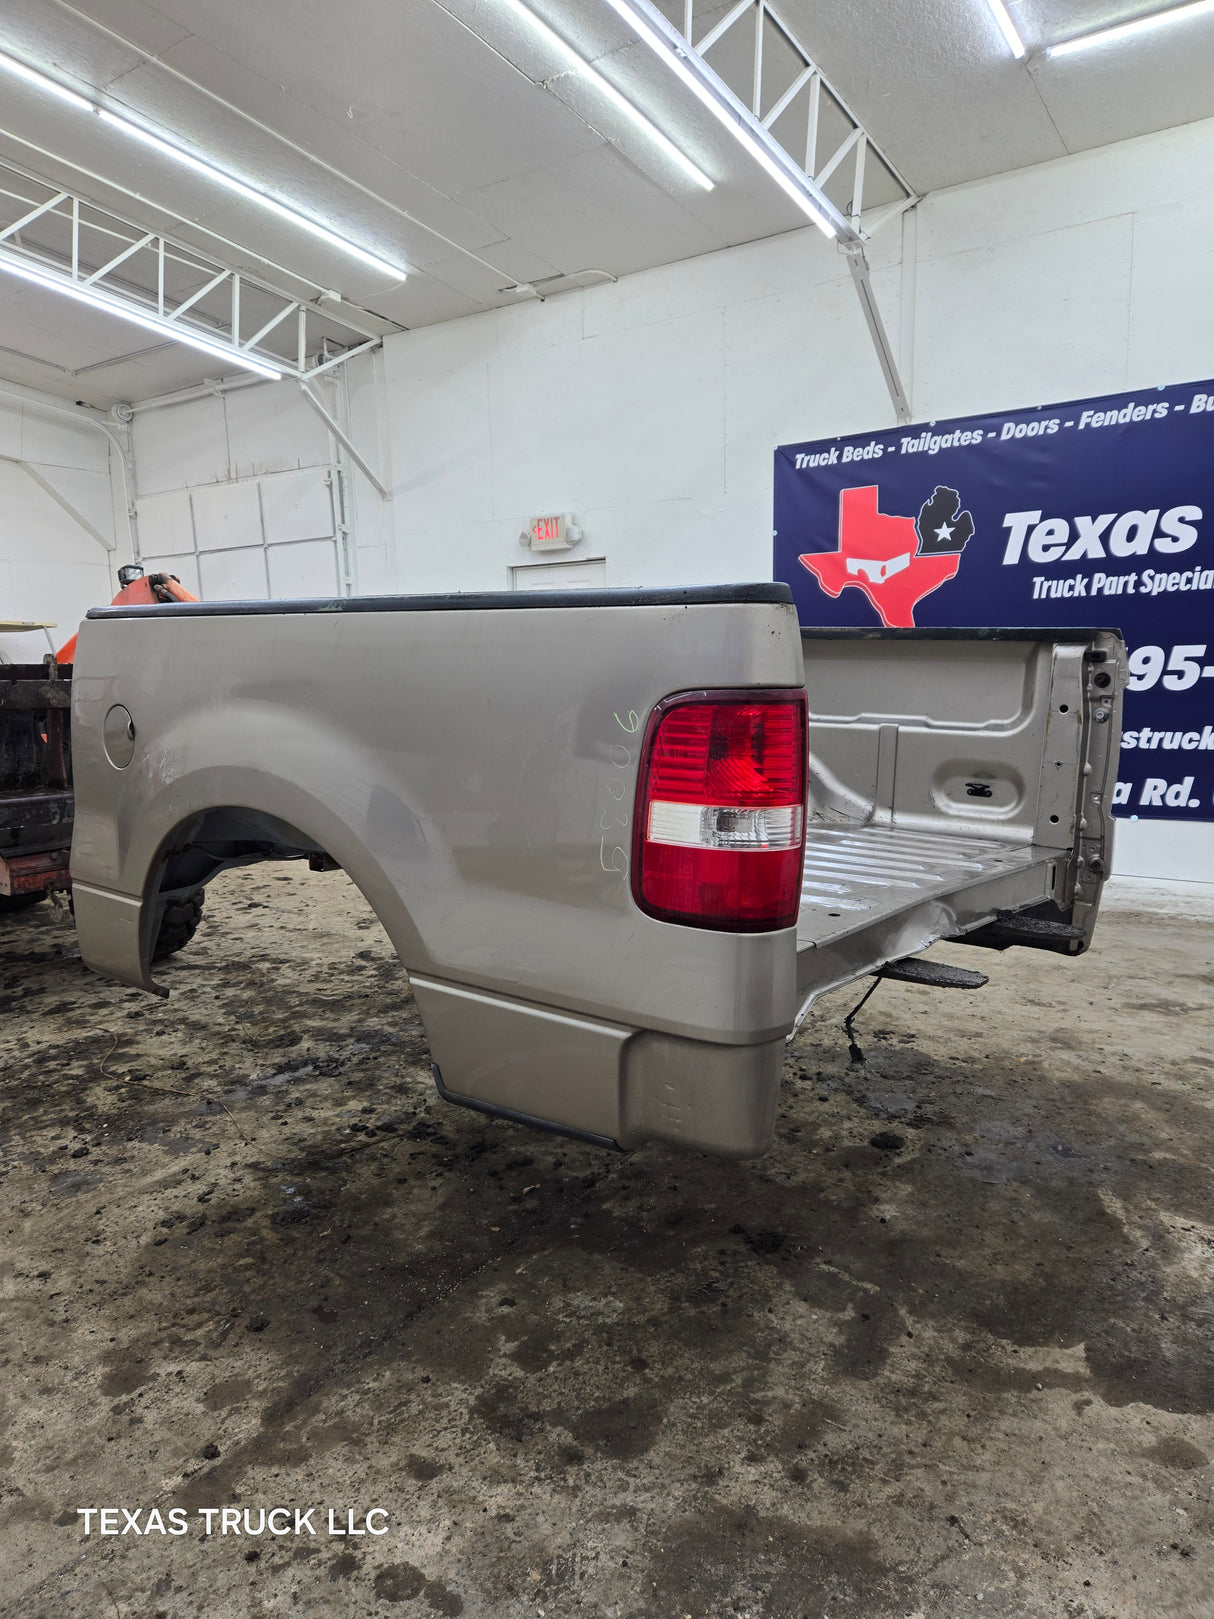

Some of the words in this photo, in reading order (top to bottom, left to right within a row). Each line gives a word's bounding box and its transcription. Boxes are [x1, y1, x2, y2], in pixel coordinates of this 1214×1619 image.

[795, 448, 840, 469] Truck
[842, 441, 884, 463] Beds
[900, 429, 984, 455] Tailgates
[1000, 418, 1060, 440] Doors
[1078, 402, 1170, 430] Fenders
[537, 517, 560, 541] EXIT
[1002, 505, 1203, 566] Texas
[1032, 574, 1089, 600] Truck
[1090, 572, 1138, 597] Part
[1139, 566, 1214, 596] Specia
[1125, 644, 1214, 691] 95-
[1120, 726, 1214, 750] struck
[1139, 776, 1200, 808] Rd.
